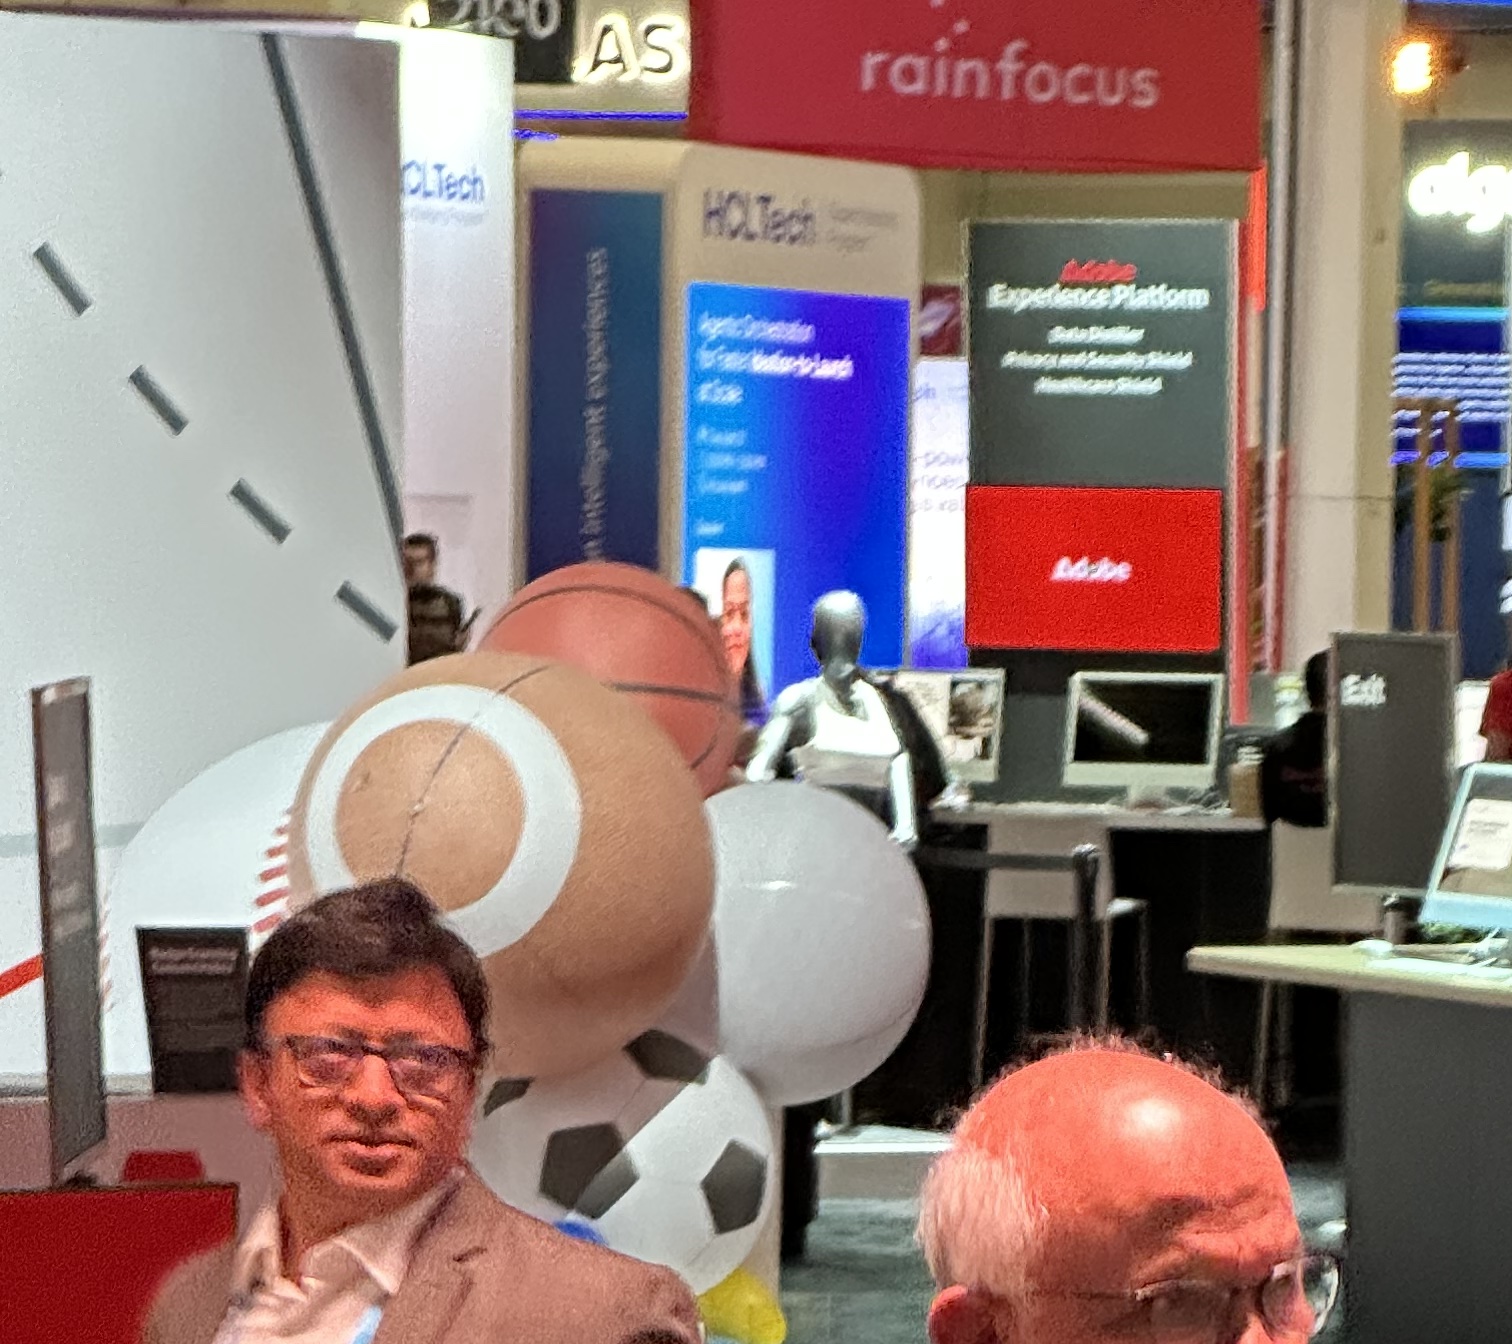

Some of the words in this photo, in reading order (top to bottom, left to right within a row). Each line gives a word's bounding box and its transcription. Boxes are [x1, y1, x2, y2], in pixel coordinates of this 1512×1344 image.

[859, 38, 1160, 108] rainfocus
[401, 158, 485, 201] CLTech
[703, 188, 816, 246] HCLTech
[986, 283, 1112, 314] Experience
[1109, 283, 1211, 311] Platform
[1049, 556, 1133, 583] Adobe
